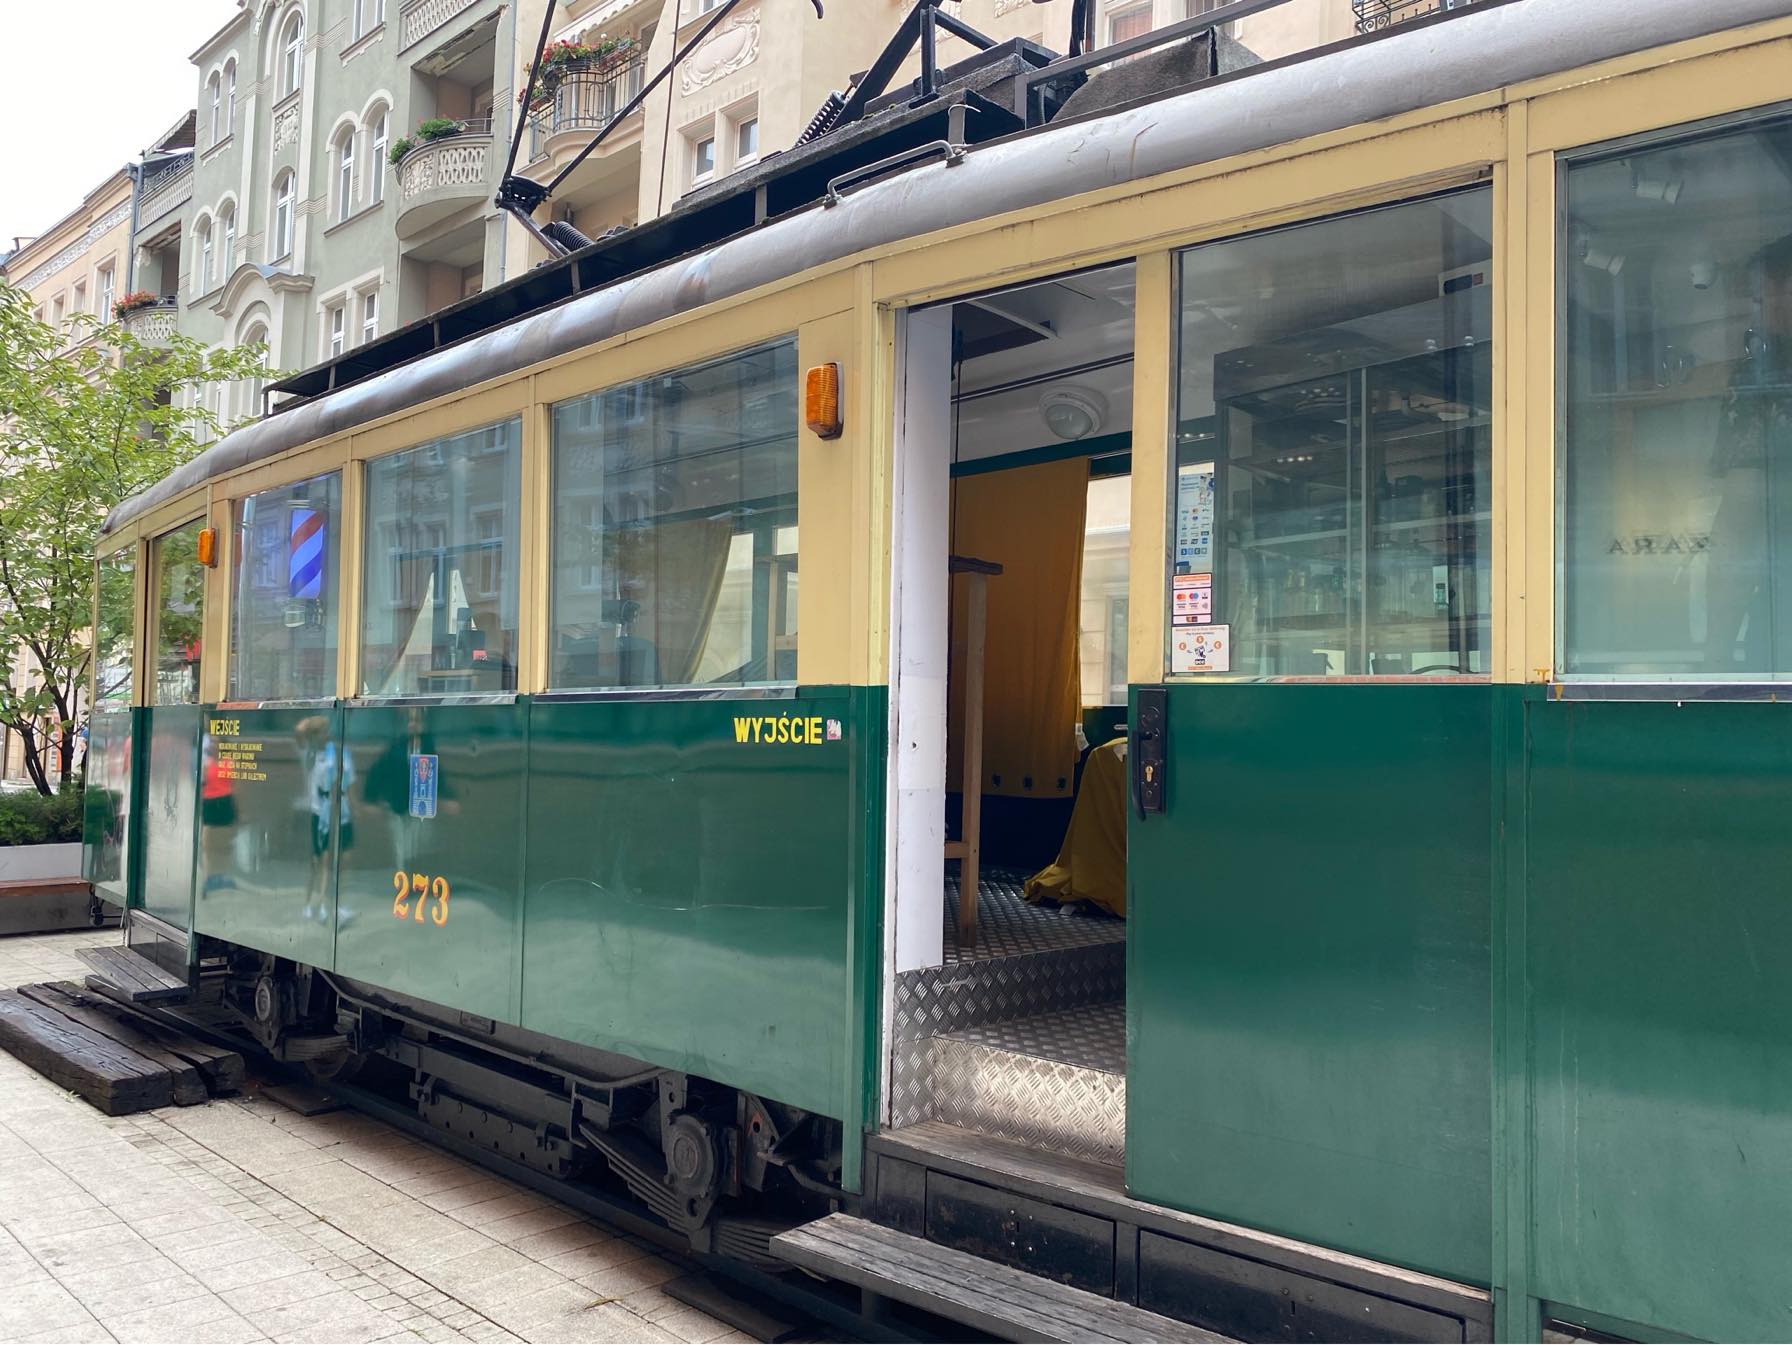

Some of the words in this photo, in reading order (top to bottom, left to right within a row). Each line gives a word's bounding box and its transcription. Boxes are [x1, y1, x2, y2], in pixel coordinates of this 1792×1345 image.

[210, 717, 240, 736] WEJŚCIE
[734, 711, 823, 744] WYJŚCIE
[393, 871, 450, 927] 273
